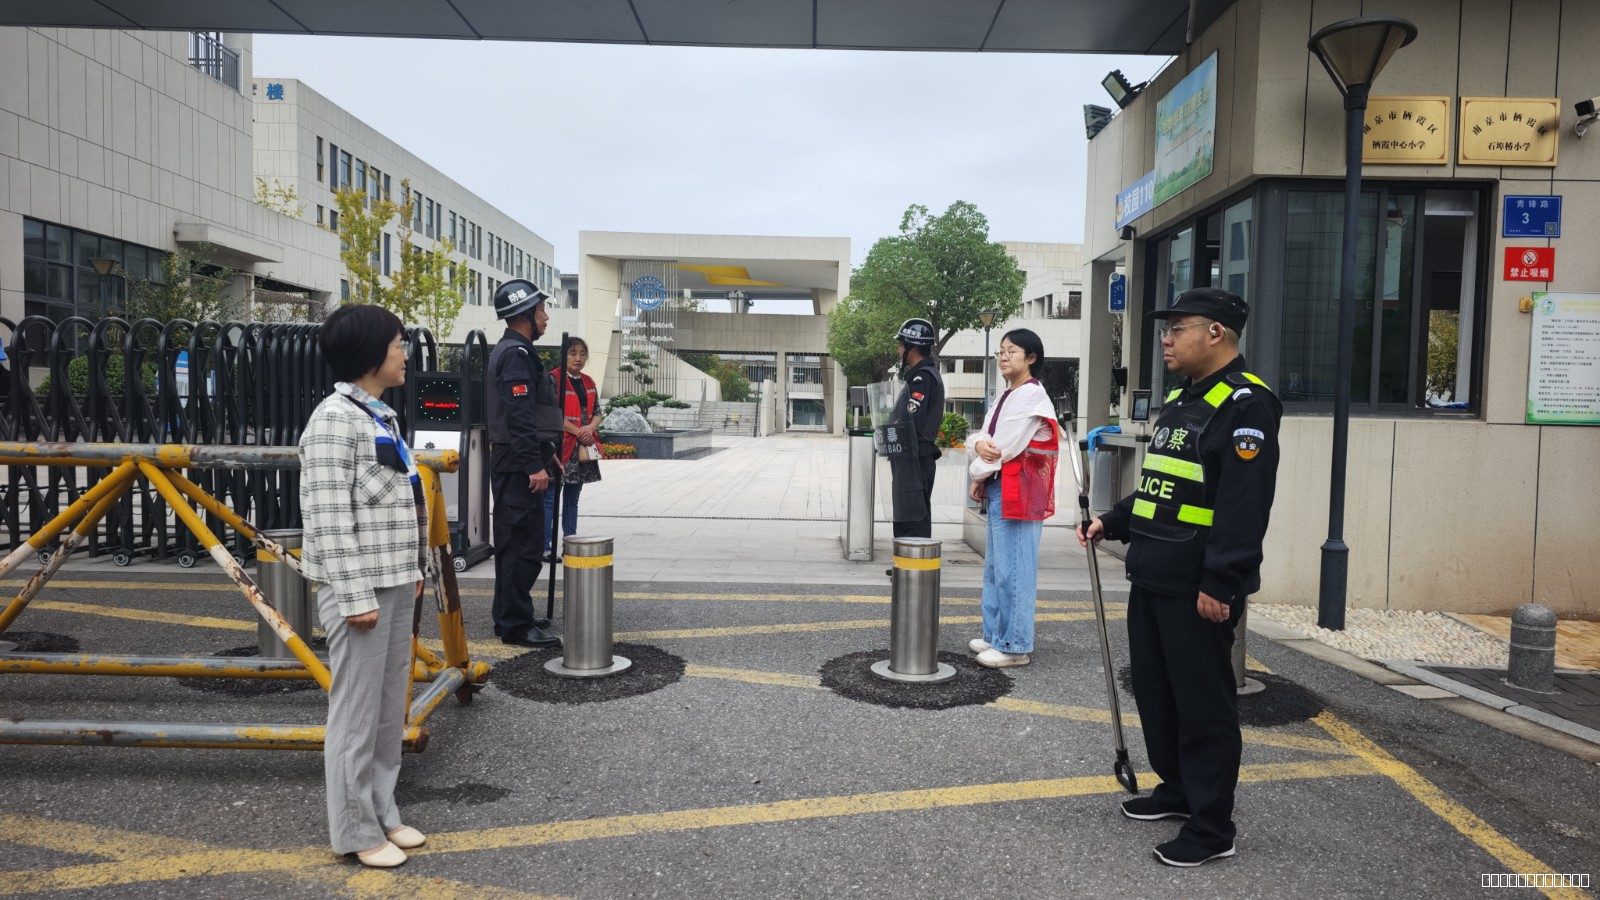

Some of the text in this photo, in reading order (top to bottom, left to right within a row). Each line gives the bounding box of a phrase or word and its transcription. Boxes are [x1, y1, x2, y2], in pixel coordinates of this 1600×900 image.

[253, 83, 284, 101] 楼
[1363, 111, 1438, 135] 南京市栖霞区
[1472, 112, 1548, 137] 南京市栖霞区
[1372, 140, 1426, 150] 栖霞中心小学
[1487, 141, 1532, 151] 石埠桥小学
[1522, 212, 1530, 224] 3
[1510, 268, 1549, 278] 禁止吸烟
[508, 289, 527, 304] 防暴
[888, 443, 902, 454] BAO
[1240, 441, 1257, 451] 保安
[1138, 475, 1175, 499] LICE
